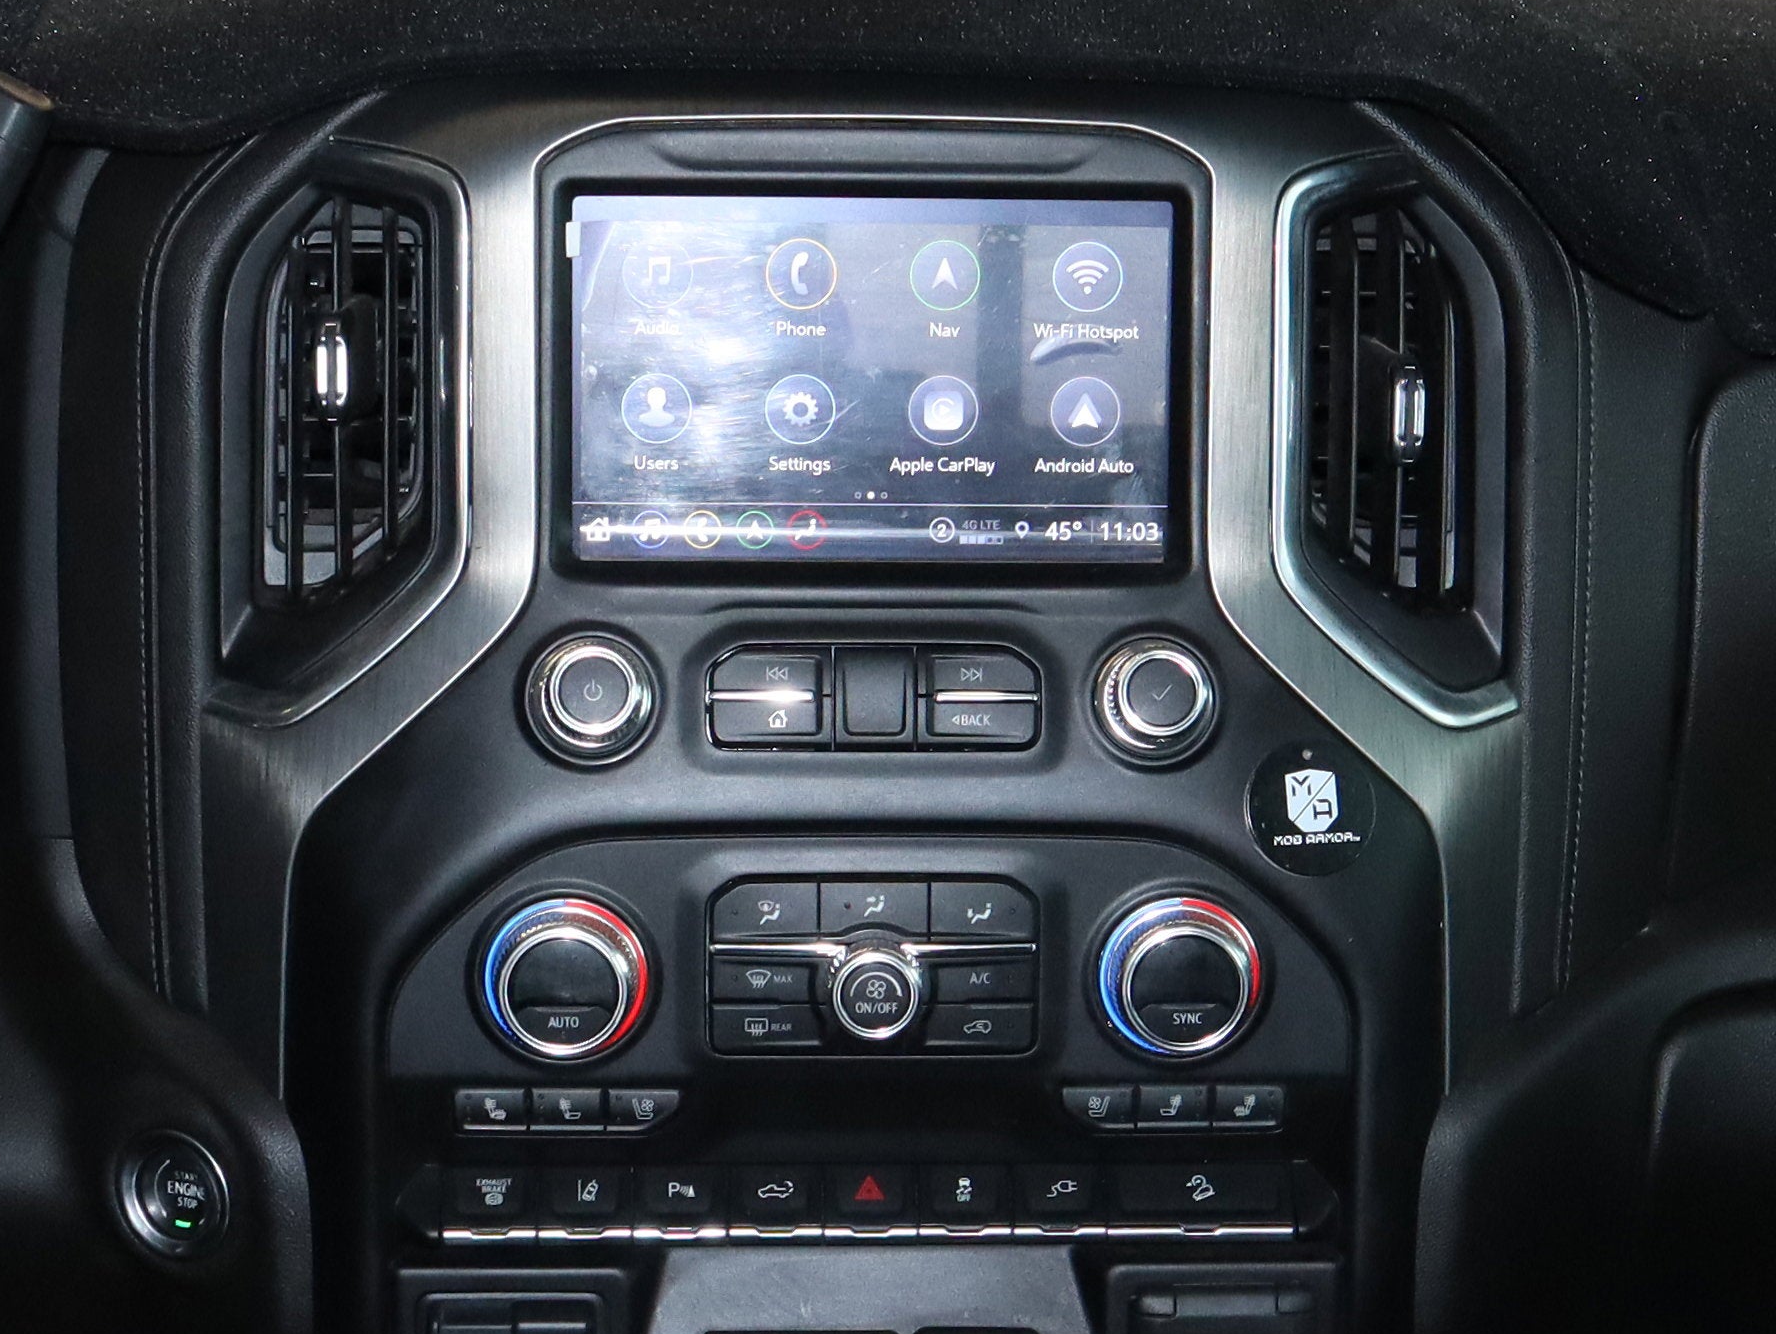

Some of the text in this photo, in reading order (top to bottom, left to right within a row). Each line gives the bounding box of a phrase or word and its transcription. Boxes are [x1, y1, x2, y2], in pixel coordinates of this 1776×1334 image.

[634, 320, 681, 335] Audio
[776, 320, 827, 337] Phone
[929, 322, 960, 338] Nav
[1034, 323, 1139, 343] Wi-Fi Hotspot
[634, 455, 679, 471] Users
[768, 455, 831, 475] Settings
[889, 457, 996, 477] Apple CarPlay
[1034, 458, 1135, 474] Android Auto
[961, 519, 1002, 531] 4G LTE
[1044, 520, 1083, 542] 45°
[1100, 521, 1160, 542] 11:03
[961, 714, 991, 726] BACK
[1273, 835, 1303, 846] MOB
[773, 973, 793, 984] MAX
[969, 972, 991, 985] A/C
[855, 1001, 898, 1014] ON/OFF
[547, 1016, 580, 1028] AUTO
[1172, 1012, 1204, 1025] SYNC
[770, 1022, 792, 1032] REAR
[475, 1177, 513, 1187] EXHAUST
[167, 1180, 206, 1201] ENGINE
[481, 1185, 507, 1193] BRAKE
[177, 1197, 199, 1209] STOP
